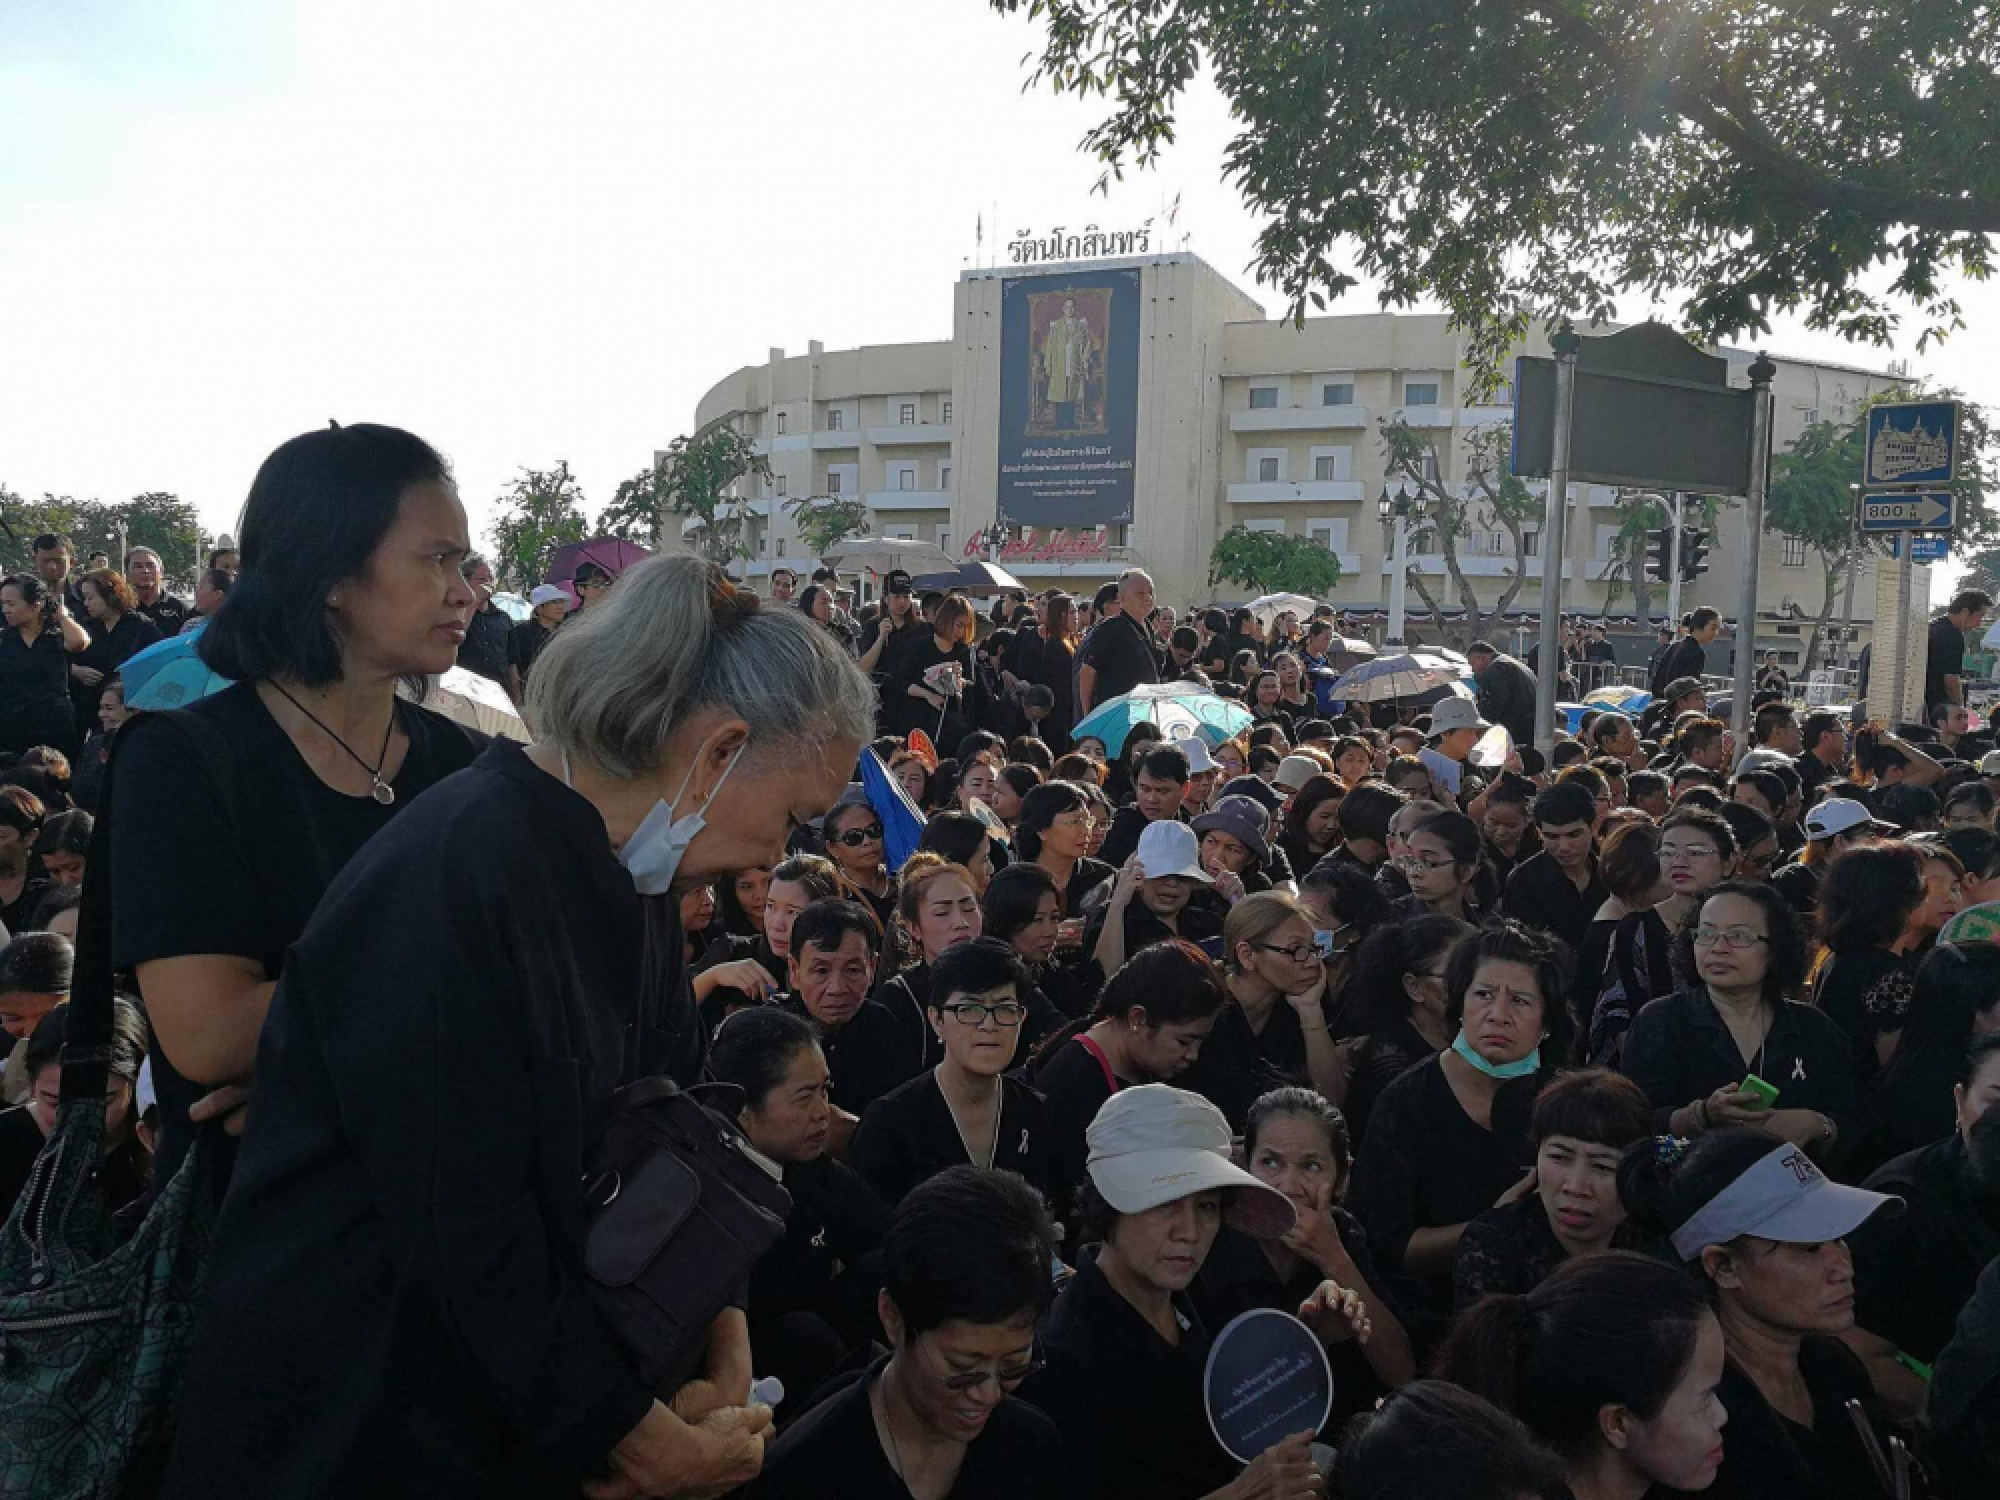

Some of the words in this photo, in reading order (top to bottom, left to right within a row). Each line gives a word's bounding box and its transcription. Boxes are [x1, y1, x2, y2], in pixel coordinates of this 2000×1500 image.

[1007, 217, 1155, 264] รัตนโกสินทร์
[1869, 505, 1903, 518] 800
